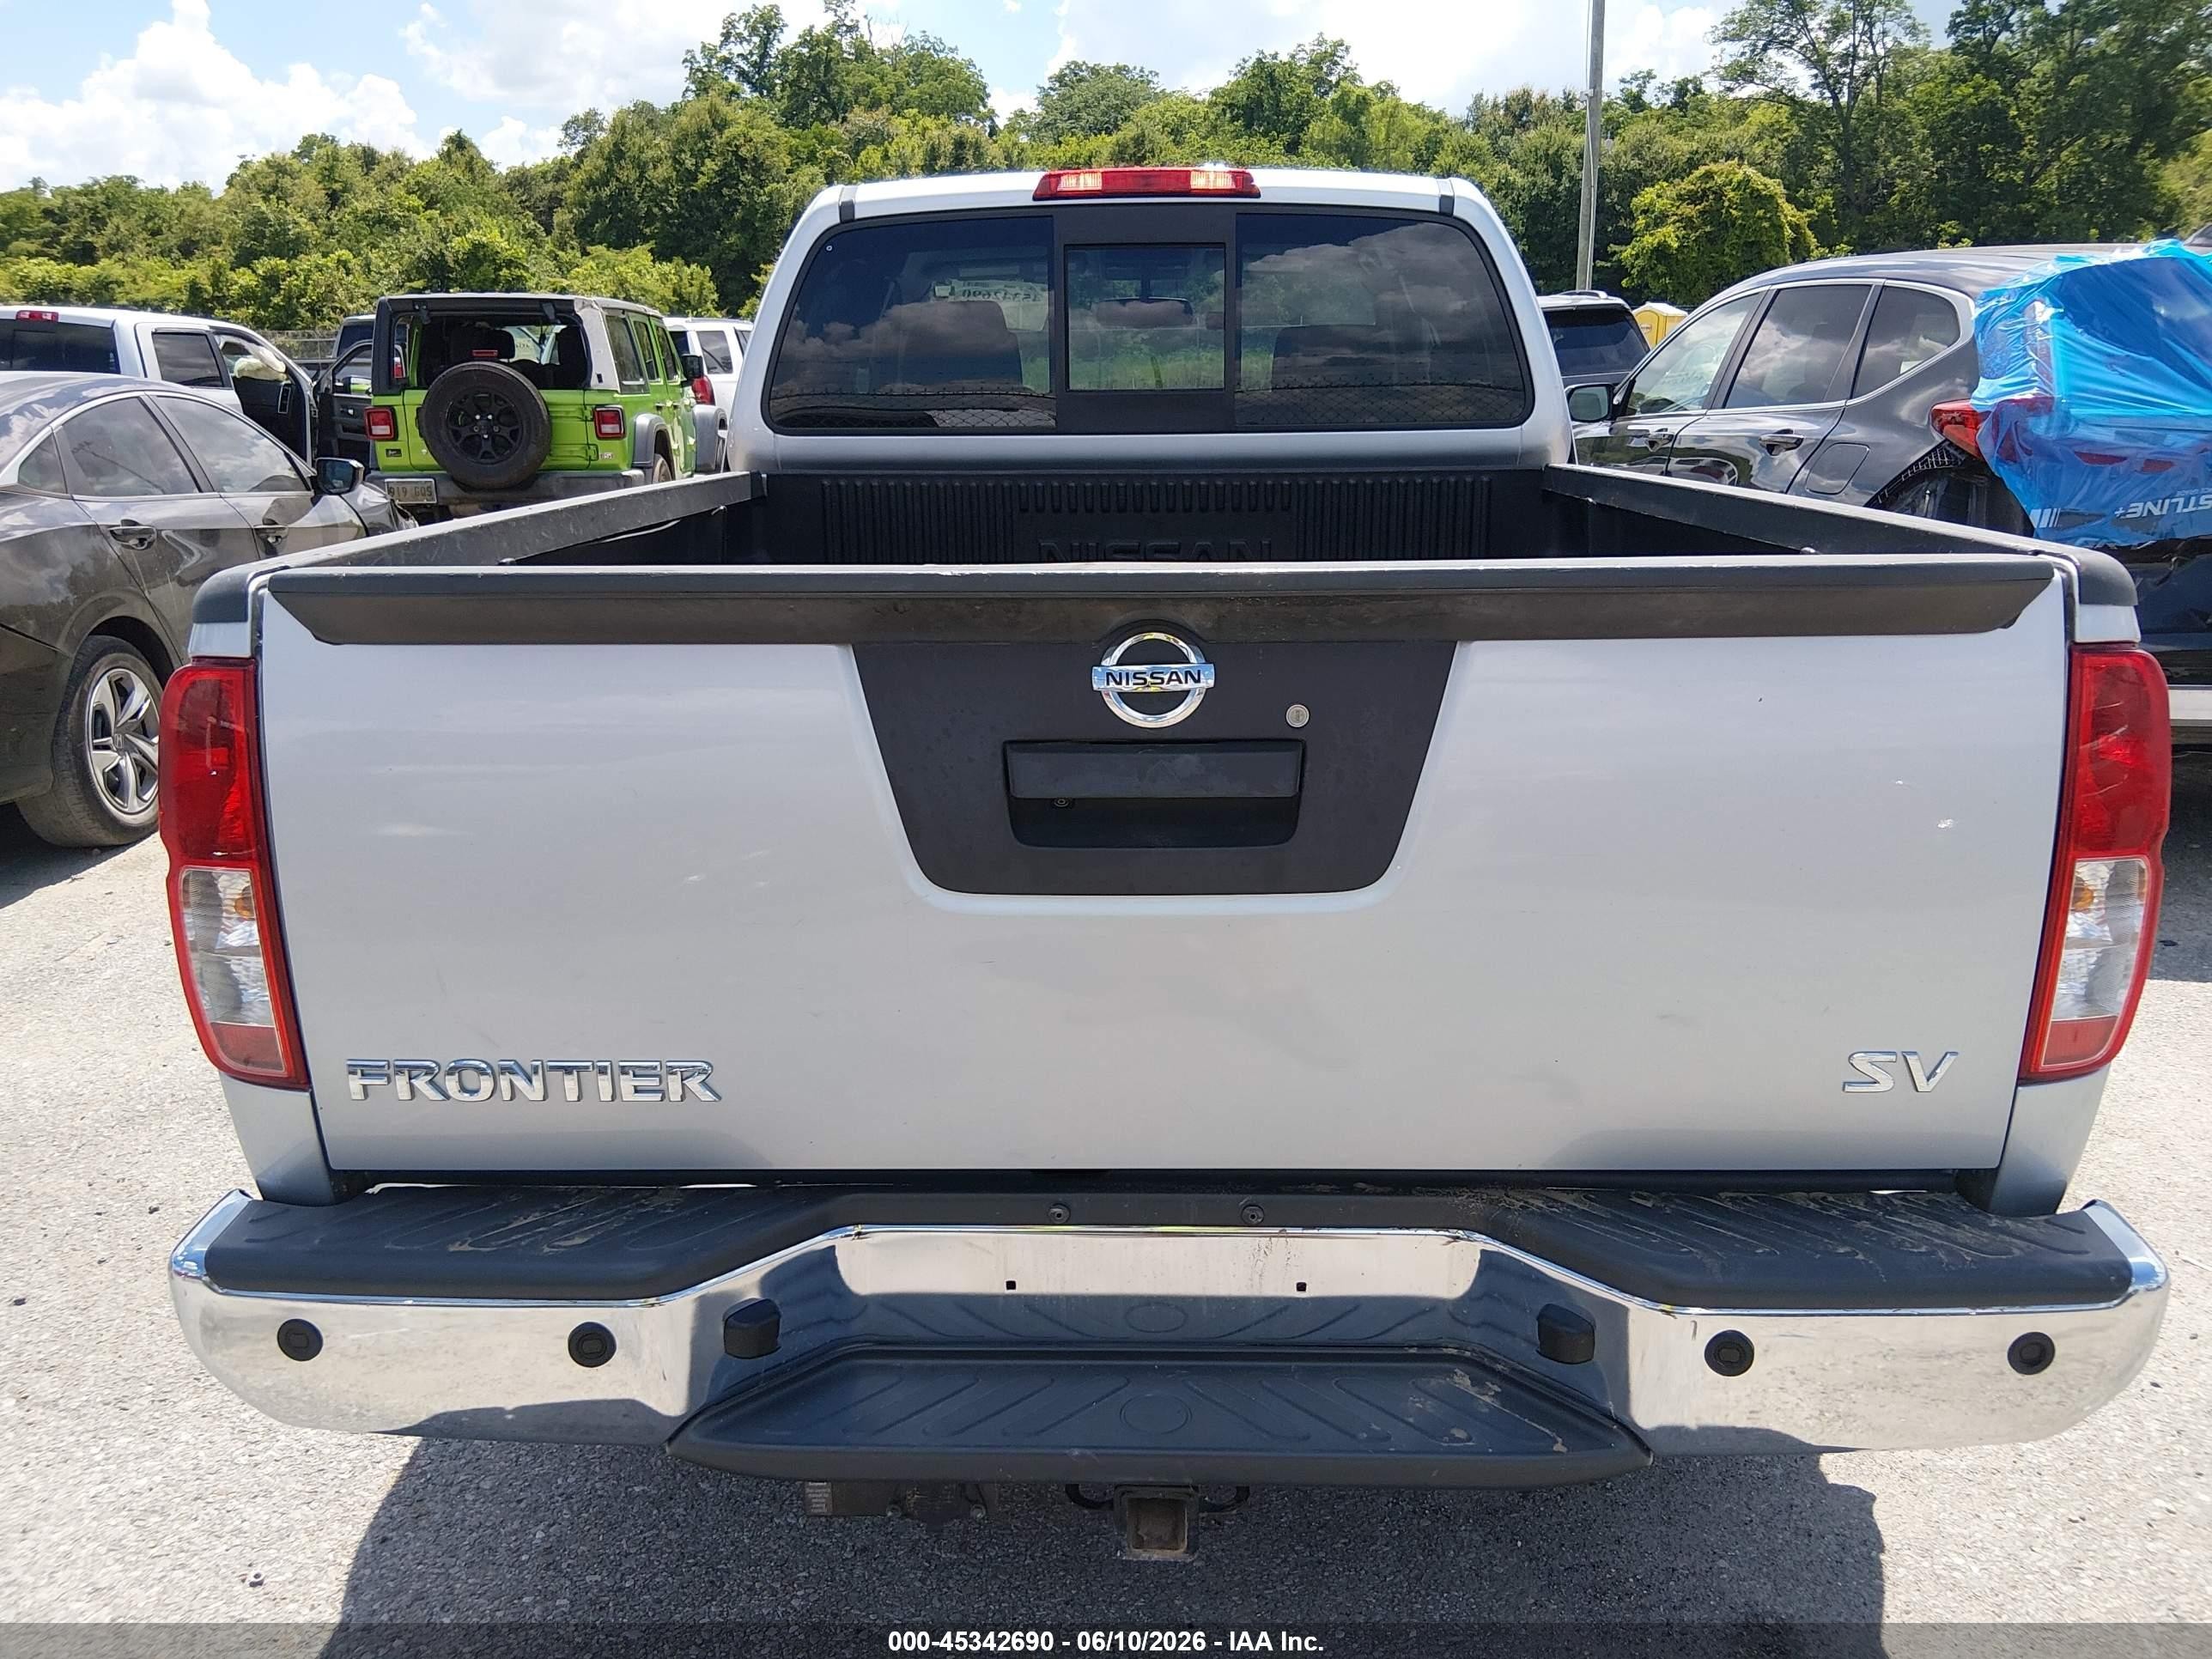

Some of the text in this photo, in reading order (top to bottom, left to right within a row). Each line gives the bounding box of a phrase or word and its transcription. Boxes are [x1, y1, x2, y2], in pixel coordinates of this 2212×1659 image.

[1104, 669, 1202, 687] NISSAN
[346, 1058, 722, 1103] FRONTIER
[1842, 1050, 1960, 1093] SV
